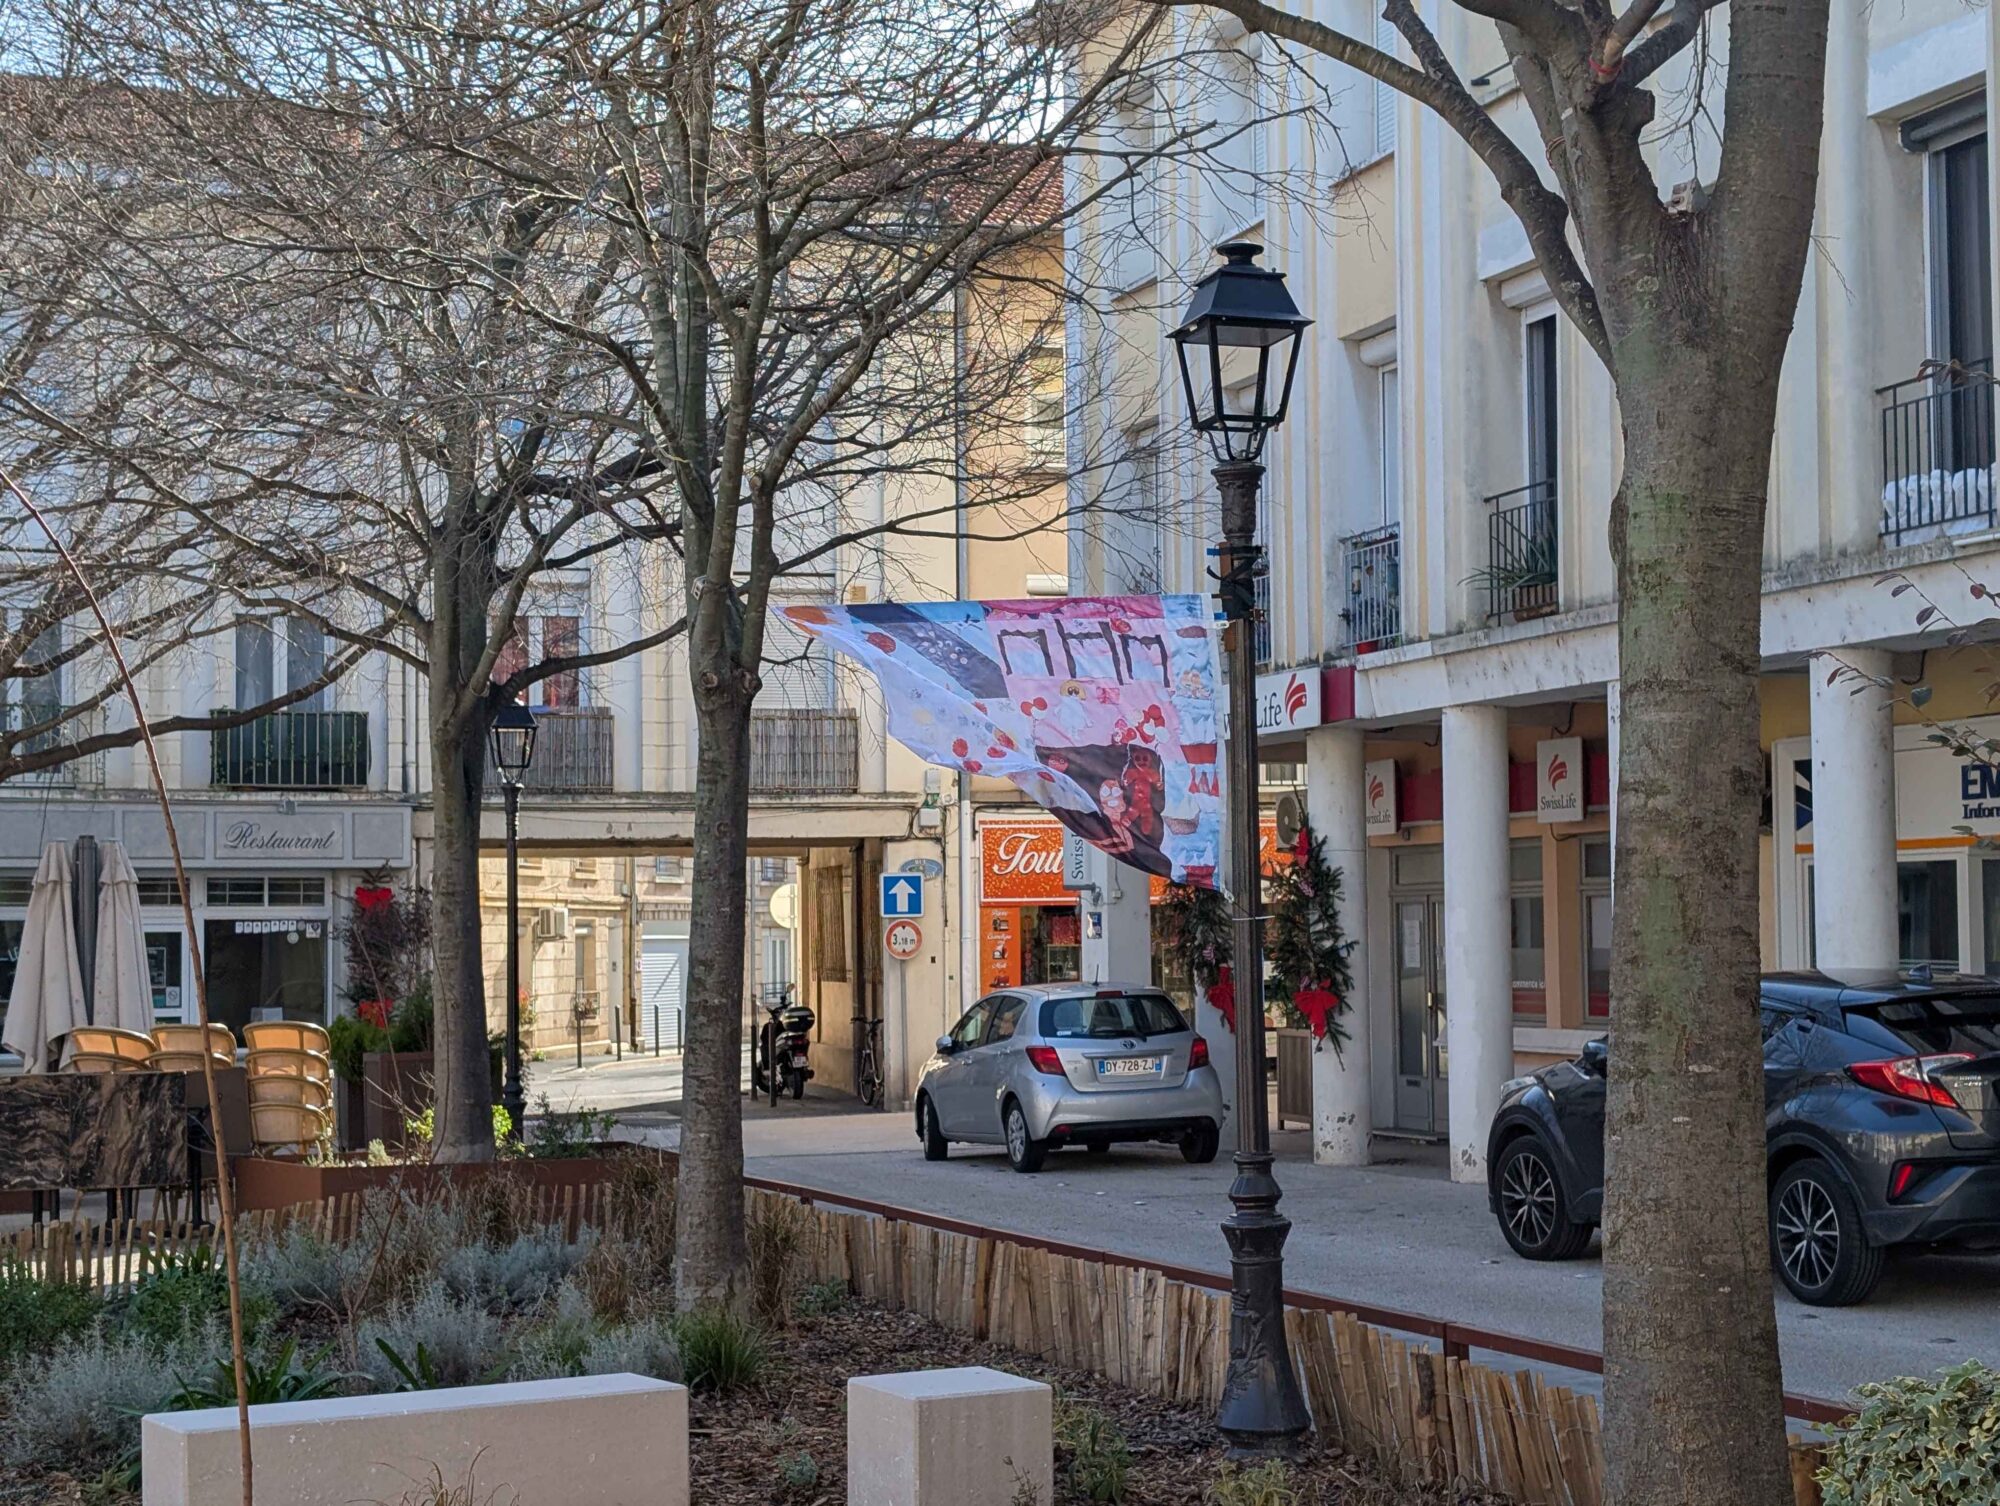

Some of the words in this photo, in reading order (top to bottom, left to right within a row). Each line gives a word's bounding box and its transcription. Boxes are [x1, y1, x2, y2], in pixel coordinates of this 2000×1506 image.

[1541, 793, 1577, 810] SwissLife
[1366, 809, 1392, 825] wissLife
[224, 821, 337, 850] Restaurant
